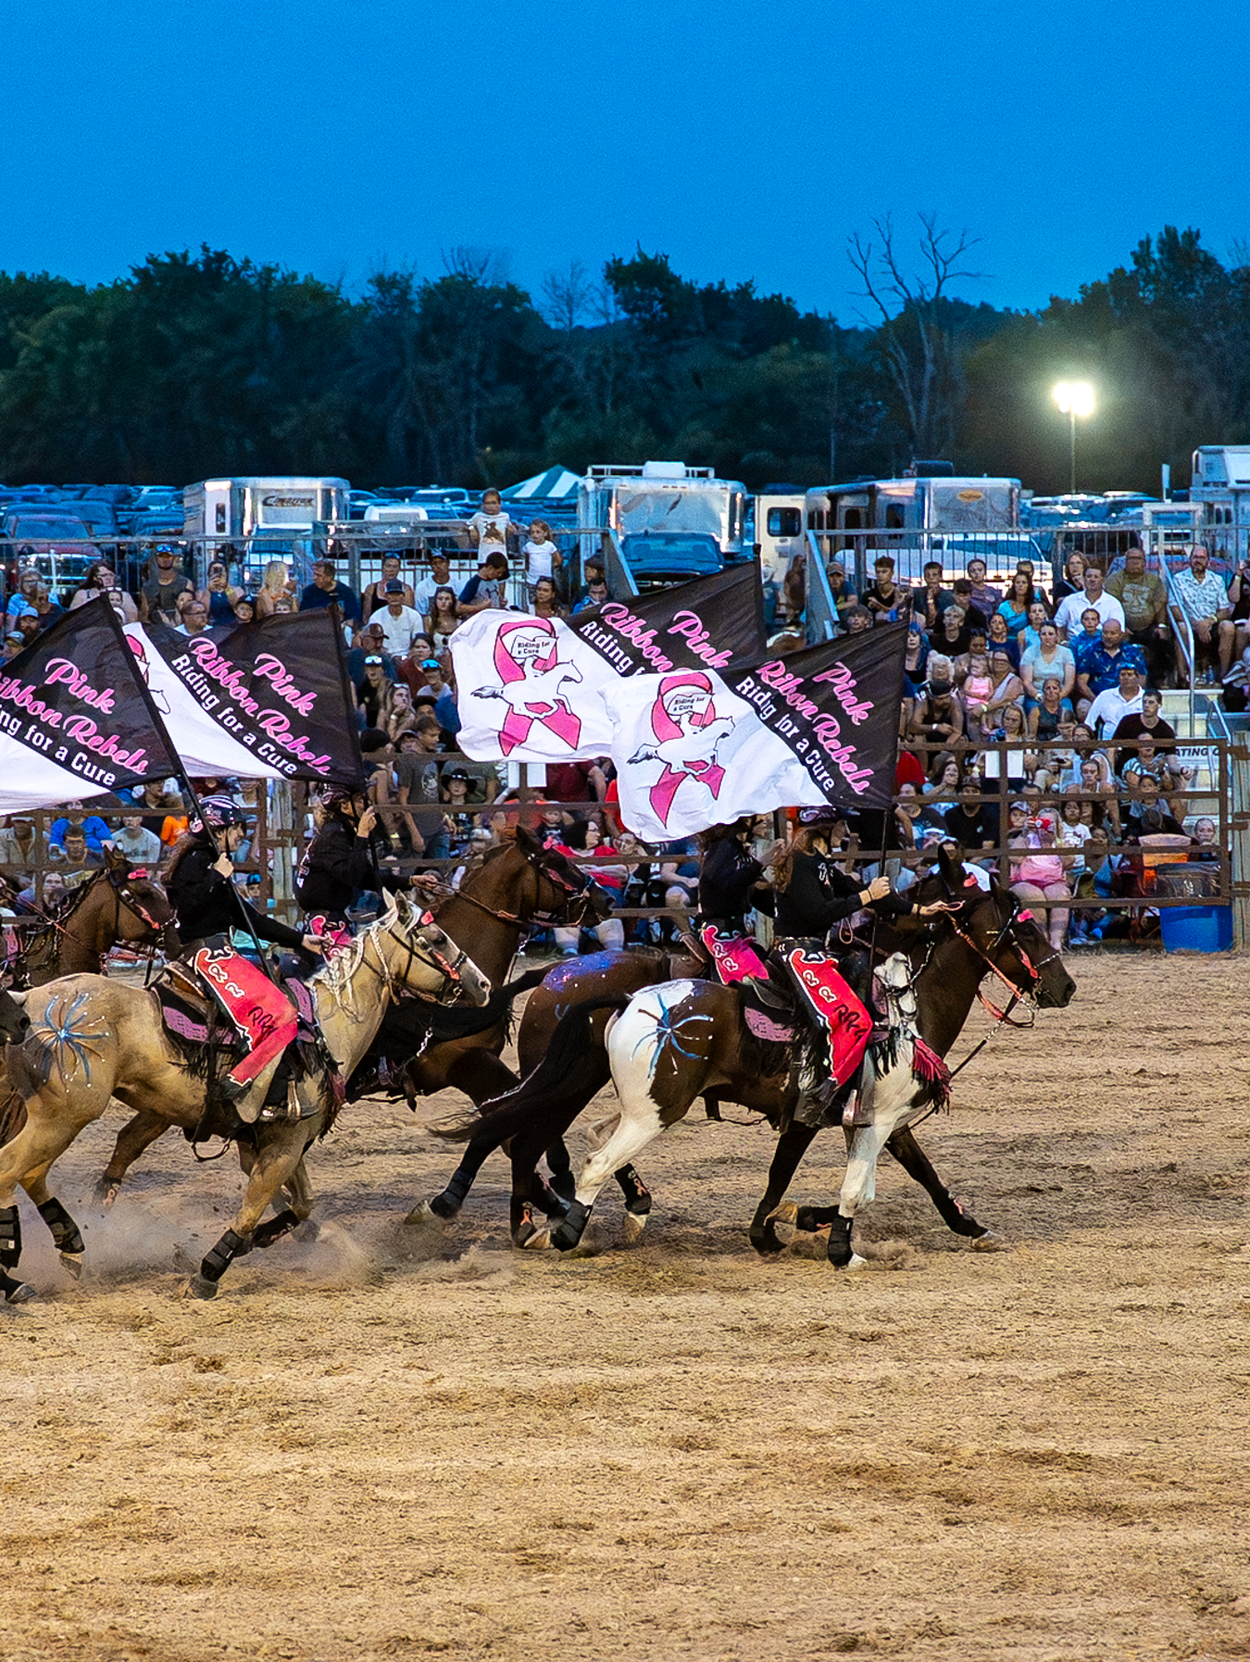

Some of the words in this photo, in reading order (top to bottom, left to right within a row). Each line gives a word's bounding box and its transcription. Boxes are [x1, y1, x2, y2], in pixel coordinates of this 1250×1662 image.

[579, 621, 634, 671] Riding
[600, 602, 674, 673] Ribbon
[667, 610, 733, 669] Pink
[44, 657, 116, 715] Pink
[171, 653, 221, 712] Riding
[216, 706, 245, 734] for
[242, 732, 257, 746] a
[257, 742, 298, 775] Cure
[188, 637, 260, 718] Ribbon
[255, 709, 332, 776] Rebels
[252, 653, 318, 717] Pink
[812, 661, 875, 726] Pink
[24, 725, 54, 752] for
[54, 749, 69, 766] a
[70, 754, 117, 787] Cure
[62, 714, 151, 776] Rebels
[735, 675, 777, 721] Ridg
[796, 738, 810, 754] a
[804, 751, 836, 792] Cure
[812, 712, 875, 796] Rebels
